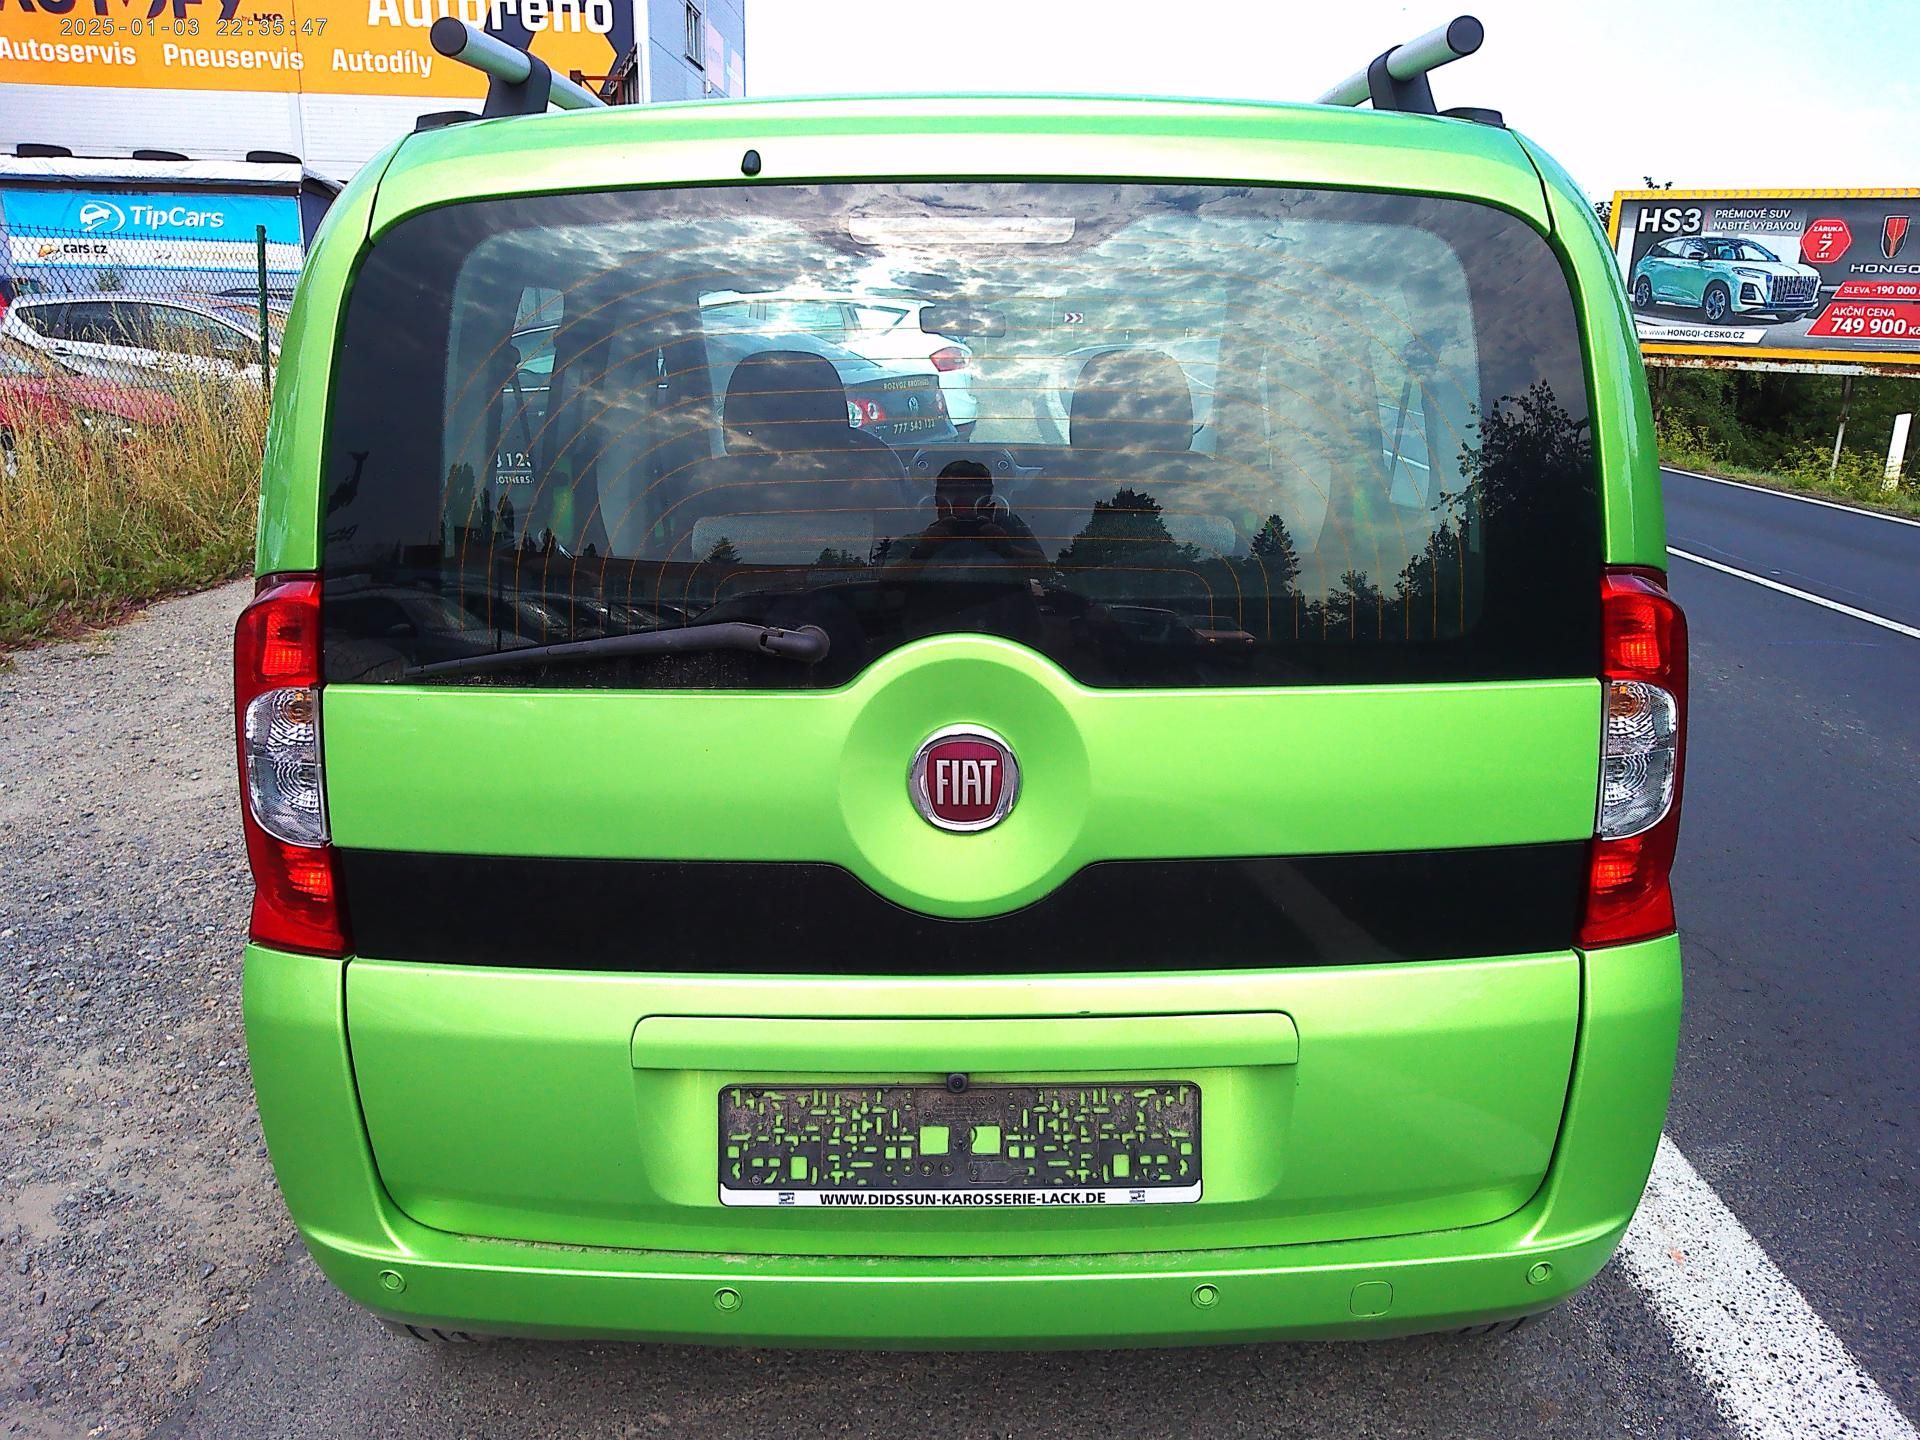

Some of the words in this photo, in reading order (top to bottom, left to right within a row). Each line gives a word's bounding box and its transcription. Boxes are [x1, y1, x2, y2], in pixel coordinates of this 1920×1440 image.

[0, 36, 137, 65] Autoservis
[162, 43, 305, 71] Pneuservis
[331, 48, 433, 78] Autodíly
[129, 205, 225, 231] TipCars
[1715, 207, 1767, 219] PRÉMIOVÉ
[1768, 209, 1791, 219] SUV
[1638, 208, 1702, 233] HS3
[1713, 219, 1750, 231] NABITÉ
[1752, 220, 1802, 232] VÝBAVOU
[1813, 225, 1844, 233] ZÁRUKA
[63, 243, 108, 254] cars.cz
[1818, 240, 1834, 252] 7
[1843, 286, 1871, 295] SLEVA
[1872, 285, 1895, 295] -190
[1896, 286, 1917, 295] 000
[1832, 306, 1866, 316] AKČNÍ
[1866, 308, 1895, 317] CENA
[1830, 317, 1865, 333] 749
[1869, 319, 1907, 335] 900
[893, 423, 908, 435] 777
[936, 759, 998, 806] FIAT
[819, 1191, 1107, 1206] WWW.DIDSSUN-KAROSSERIE-LACK.DE
